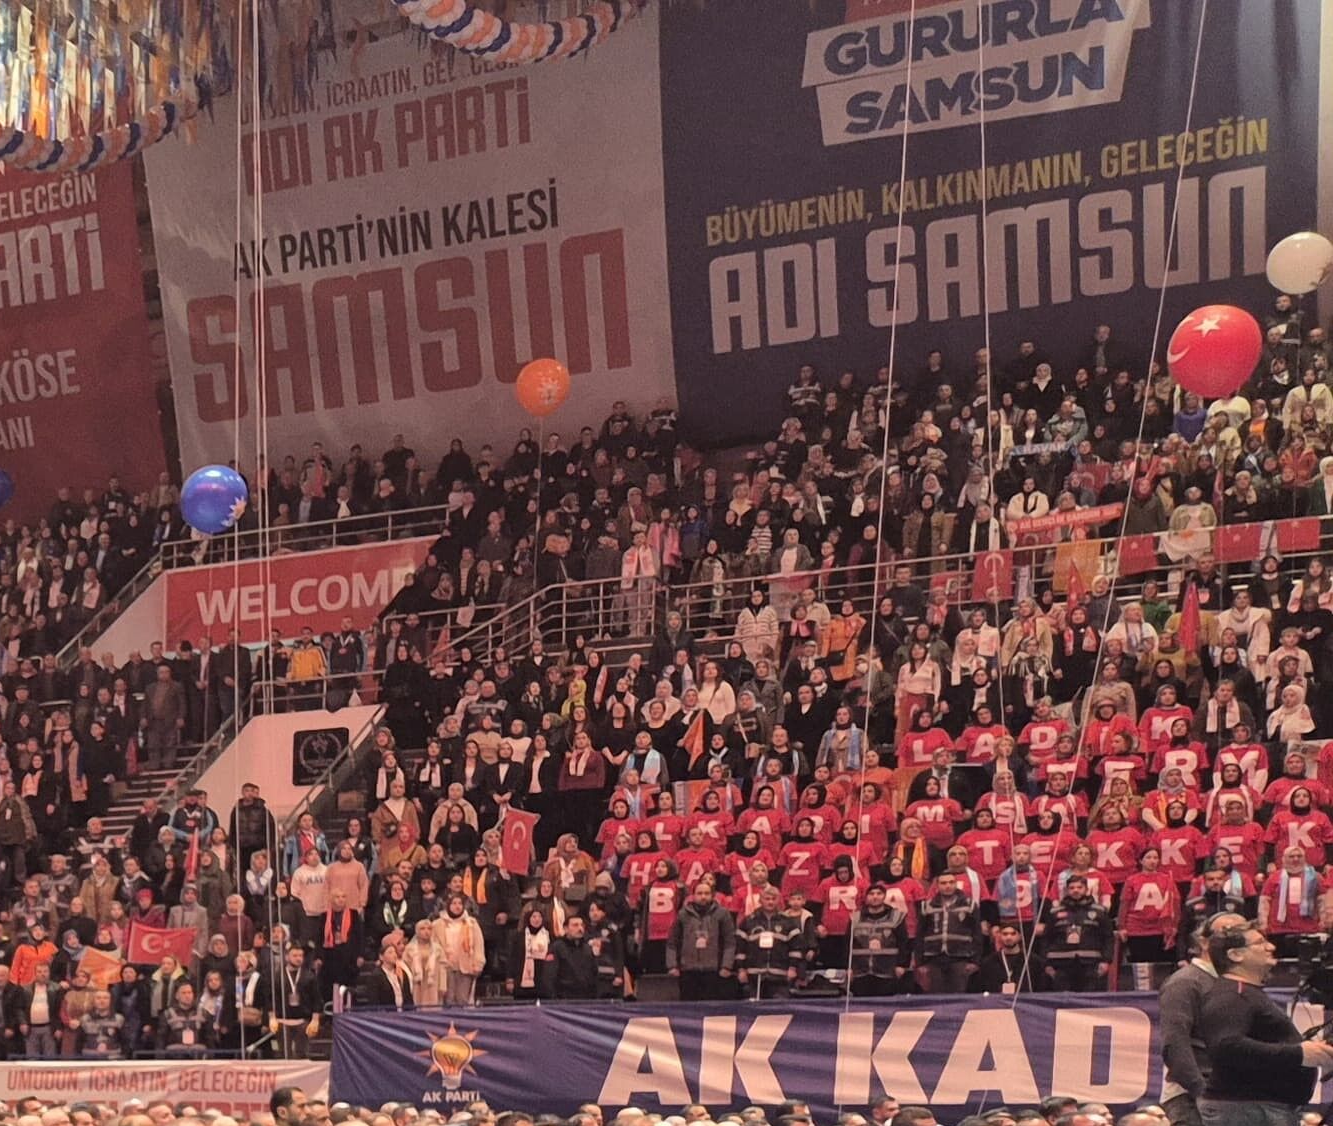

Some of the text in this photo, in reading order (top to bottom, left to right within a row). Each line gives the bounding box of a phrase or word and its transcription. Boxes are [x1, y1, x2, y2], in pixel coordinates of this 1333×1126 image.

[823, 0, 1124, 76] GURURLA
[845, 46, 1105, 134] SAMSUN
[240, 122, 313, 196] ADI
[323, 108, 384, 183] AK
[705, 115, 1268, 247] BÜYÜMENİN, KALKINMANIN, GELECEĞİN
[233, 239, 273, 282] AK
[442, 178, 559, 246] KALESİ
[708, 165, 1267, 355] ADI SAMSUN
[186, 227, 633, 424] SAMSUN
[7, 1070, 82, 1092] UMUDUN,
[423, 1090, 443, 1104] AK
[596, 1013, 795, 1106] AK
